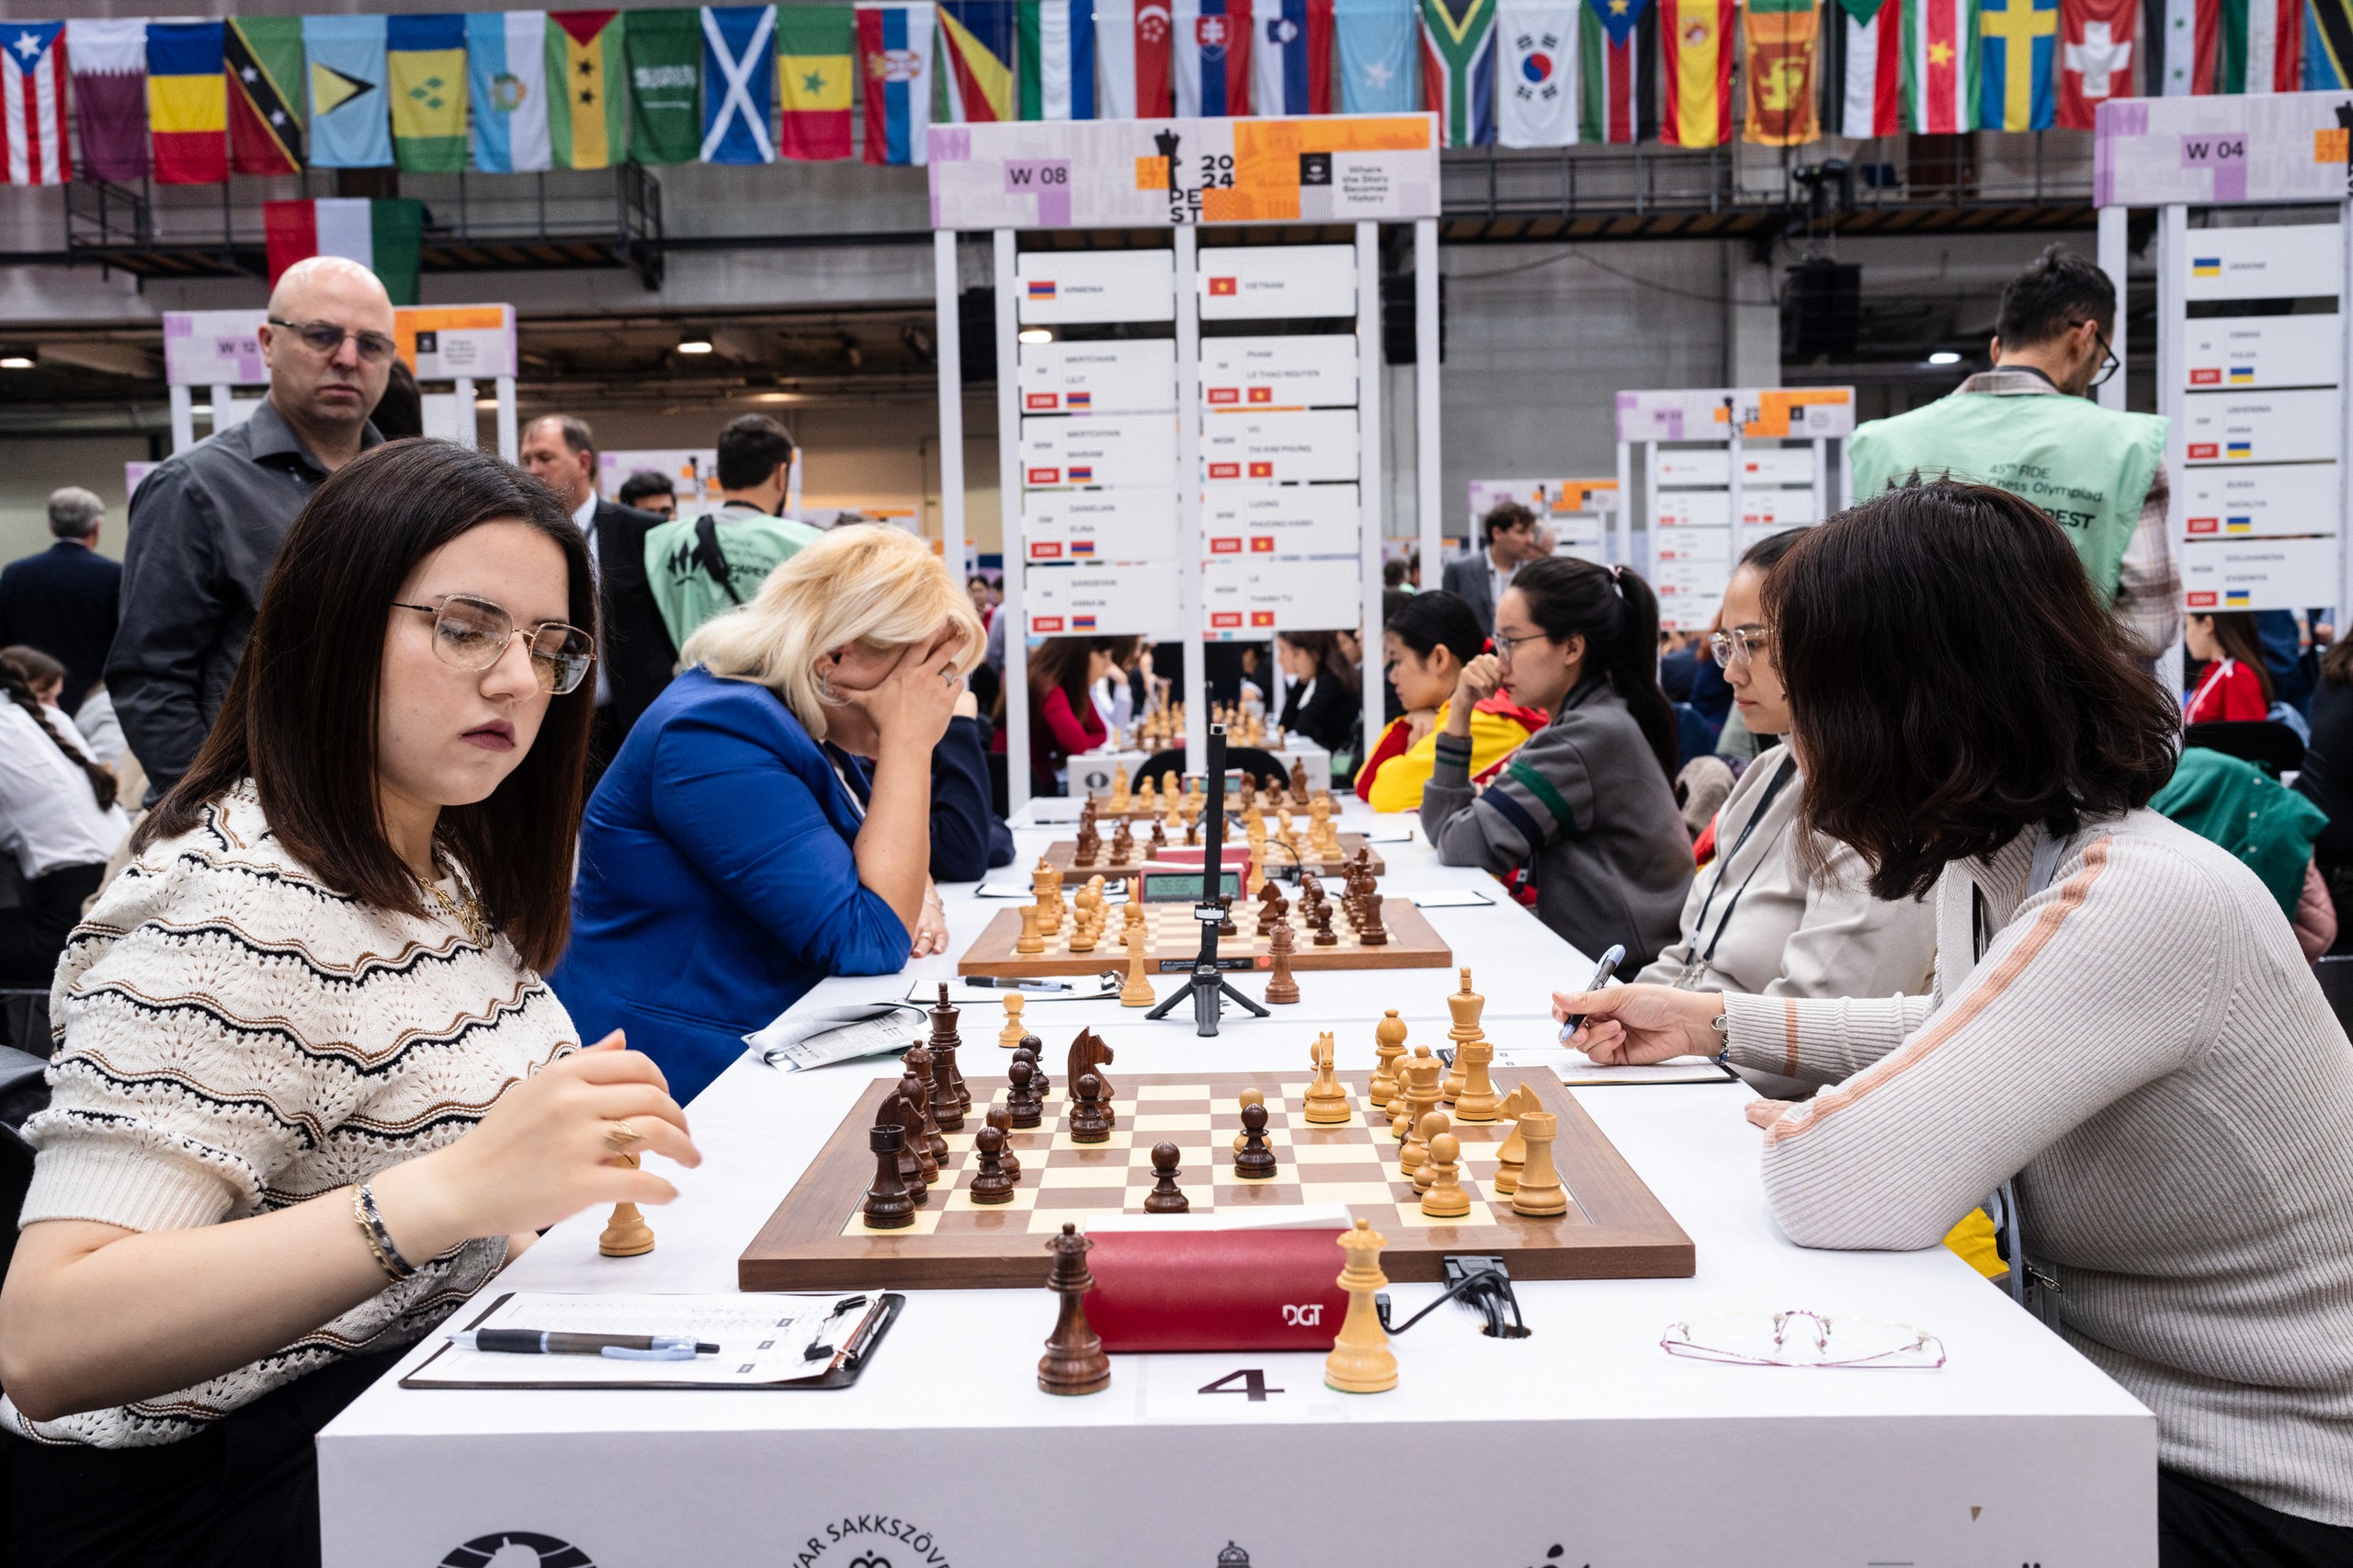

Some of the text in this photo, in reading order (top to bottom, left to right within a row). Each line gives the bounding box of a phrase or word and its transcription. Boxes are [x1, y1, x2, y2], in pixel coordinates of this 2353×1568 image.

[2187, 142, 2245, 160] W 04
[1201, 155, 1233, 170] 20
[1010, 166, 1068, 185] W 08
[1201, 173, 1234, 188] 24
[1169, 188, 1202, 204] PE
[1171, 207, 1201, 223] ST
[220, 341, 235, 353] W
[2018, 464, 2051, 479] FIDE
[2032, 482, 2103, 503] Olympiad
[1282, 1304, 1324, 1325] DGT
[1198, 1369, 1285, 1402] 4
